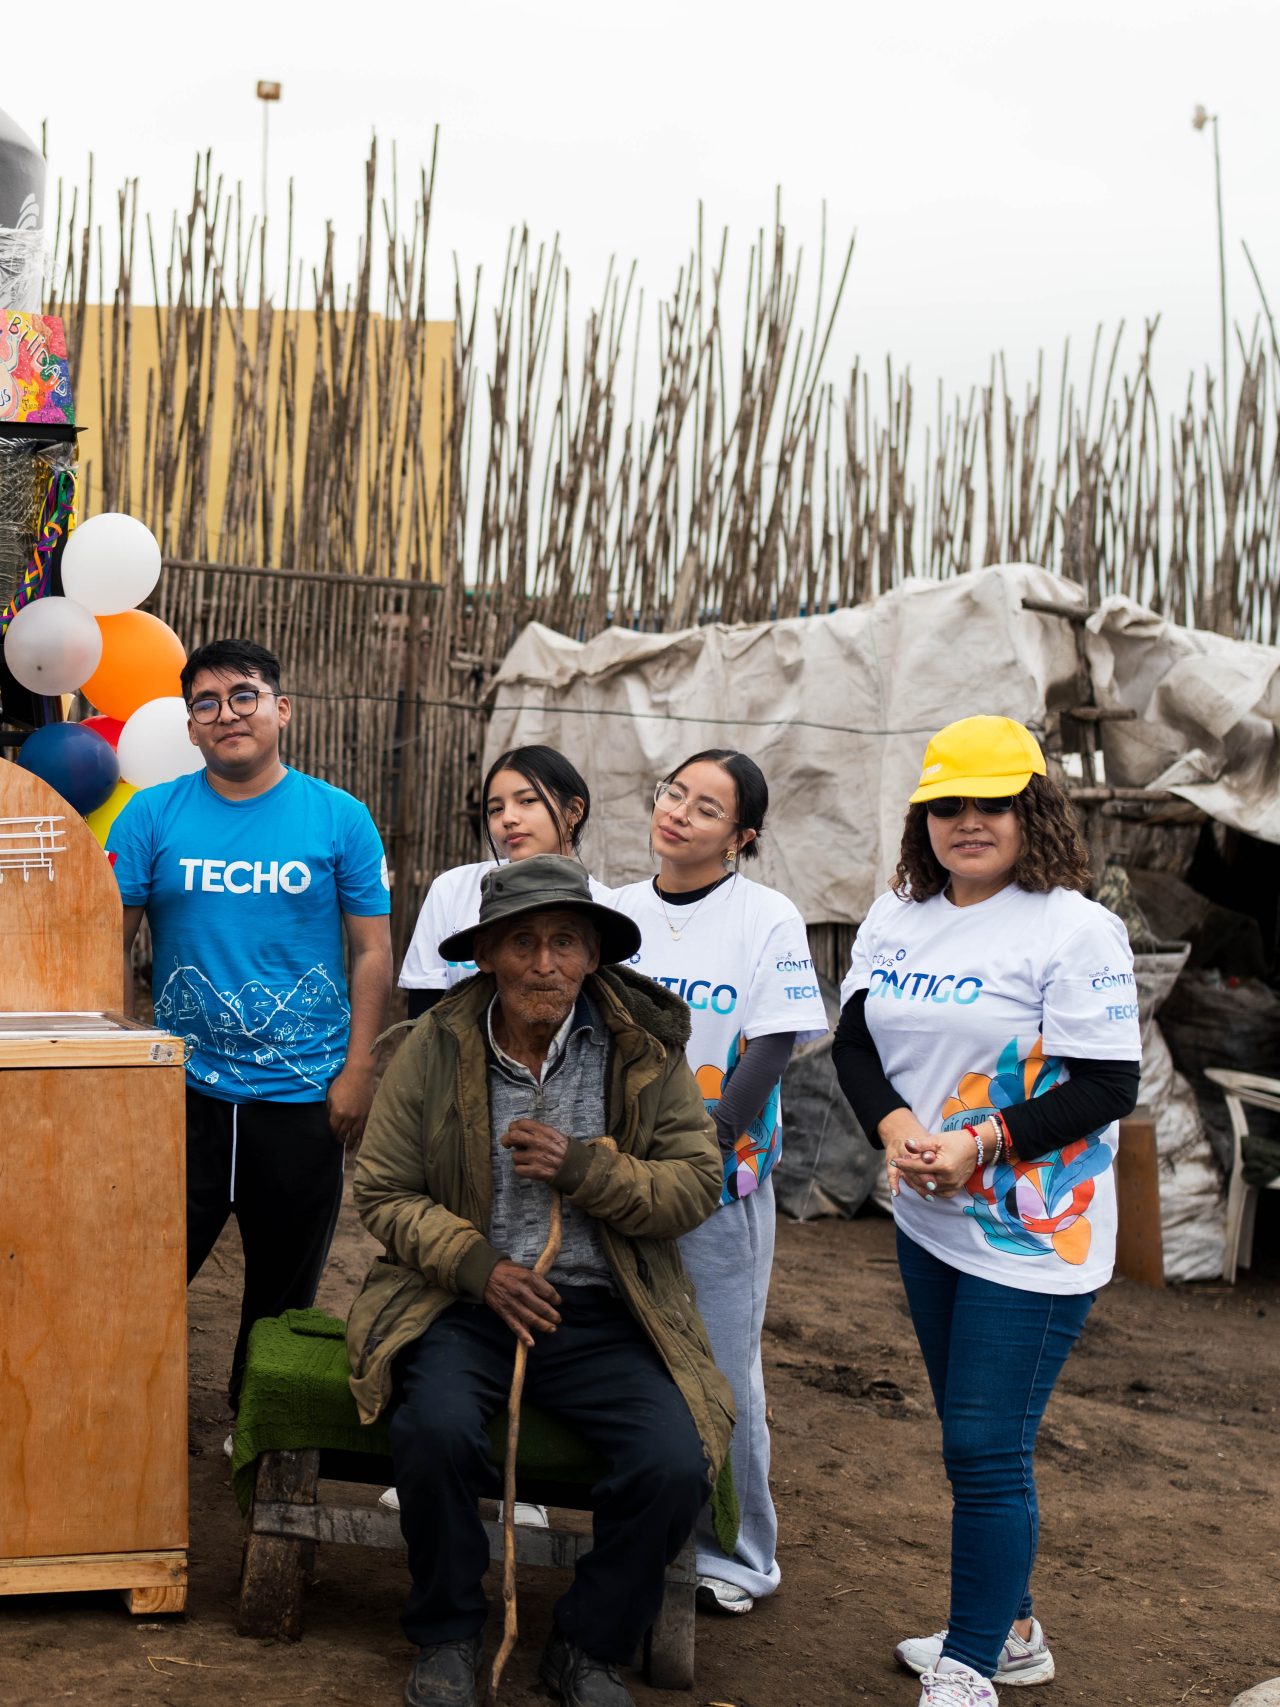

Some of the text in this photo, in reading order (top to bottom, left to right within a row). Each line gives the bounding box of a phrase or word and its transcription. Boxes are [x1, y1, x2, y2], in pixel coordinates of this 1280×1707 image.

[179, 858, 312, 895] TECHO
[776, 959, 813, 972] CONTI
[651, 976, 738, 1015] TIGO
[783, 985, 819, 1000] TECH
[868, 969, 984, 1005] ONTIGO
[1105, 1004, 1138, 1021] TECH
